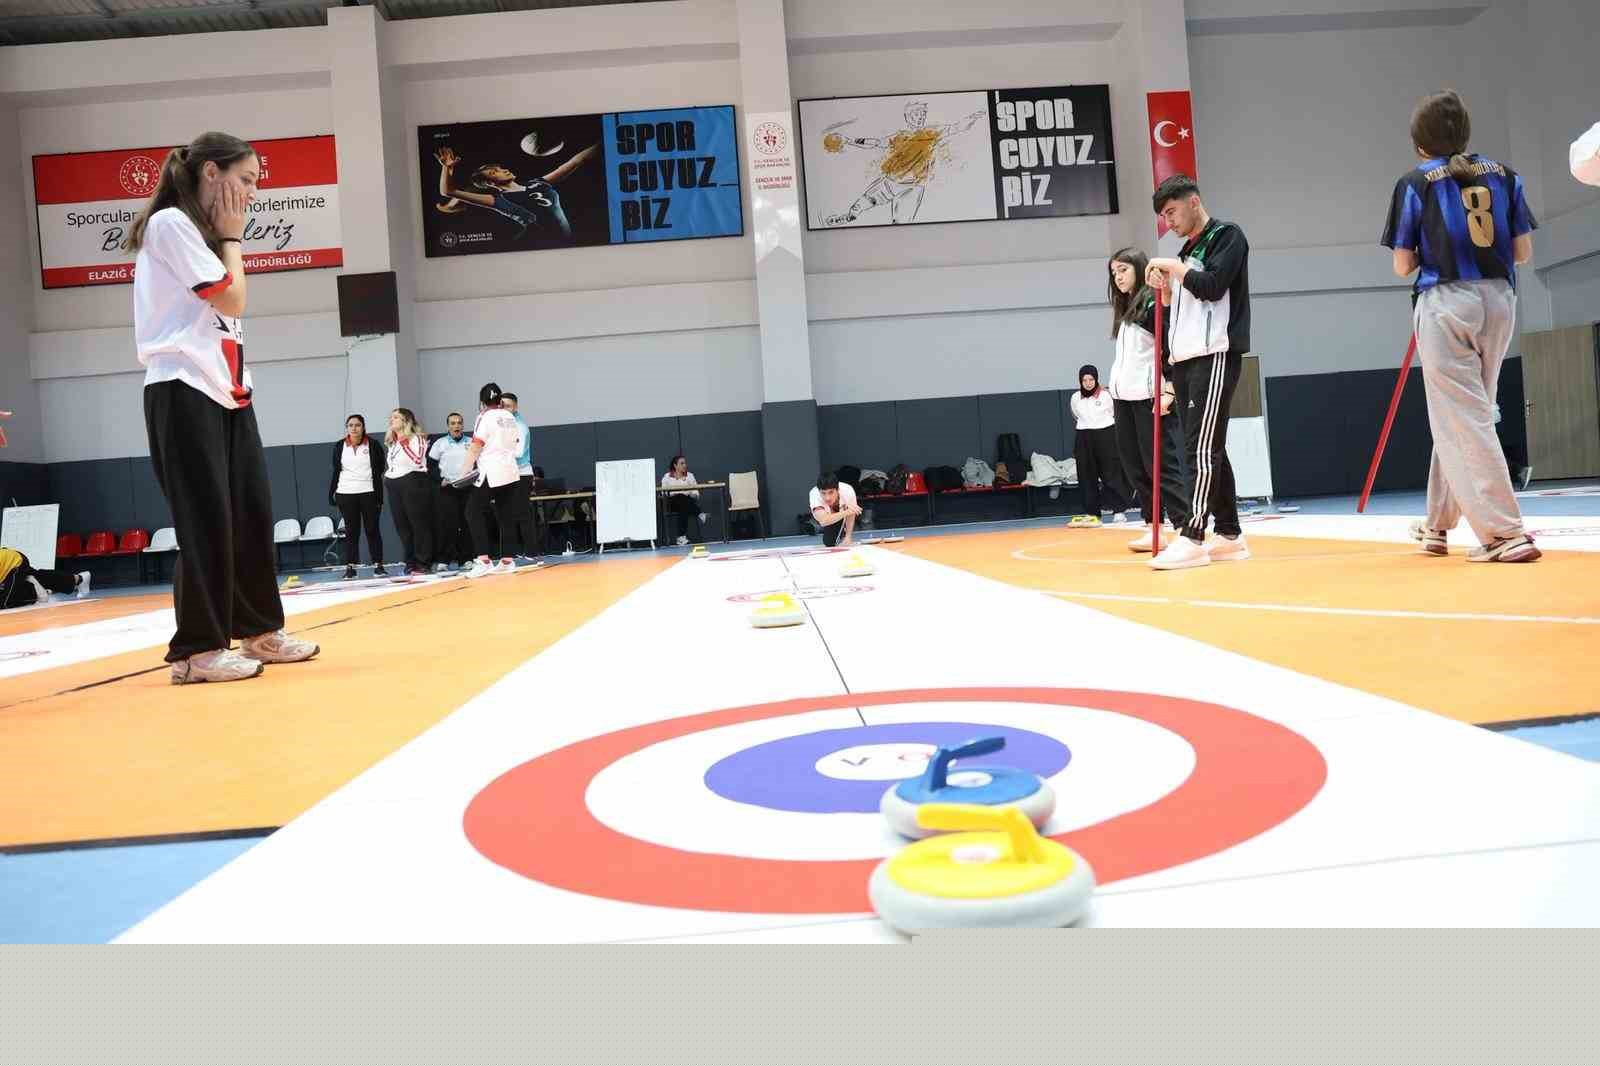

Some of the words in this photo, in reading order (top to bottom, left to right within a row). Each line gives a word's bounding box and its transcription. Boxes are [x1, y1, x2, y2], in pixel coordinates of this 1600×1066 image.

[996, 98, 1074, 132] SPOR
[616, 120, 697, 156] SPOR
[66, 209, 136, 228] Sporcular
[244, 195, 325, 213] nörlerimize
[1461, 186, 1495, 248] 8
[243, 218, 294, 250] leriz
[88, 269, 127, 280] ELAZIĞ
[243, 253, 312, 268] MÜDÜRLÜĞÜ
